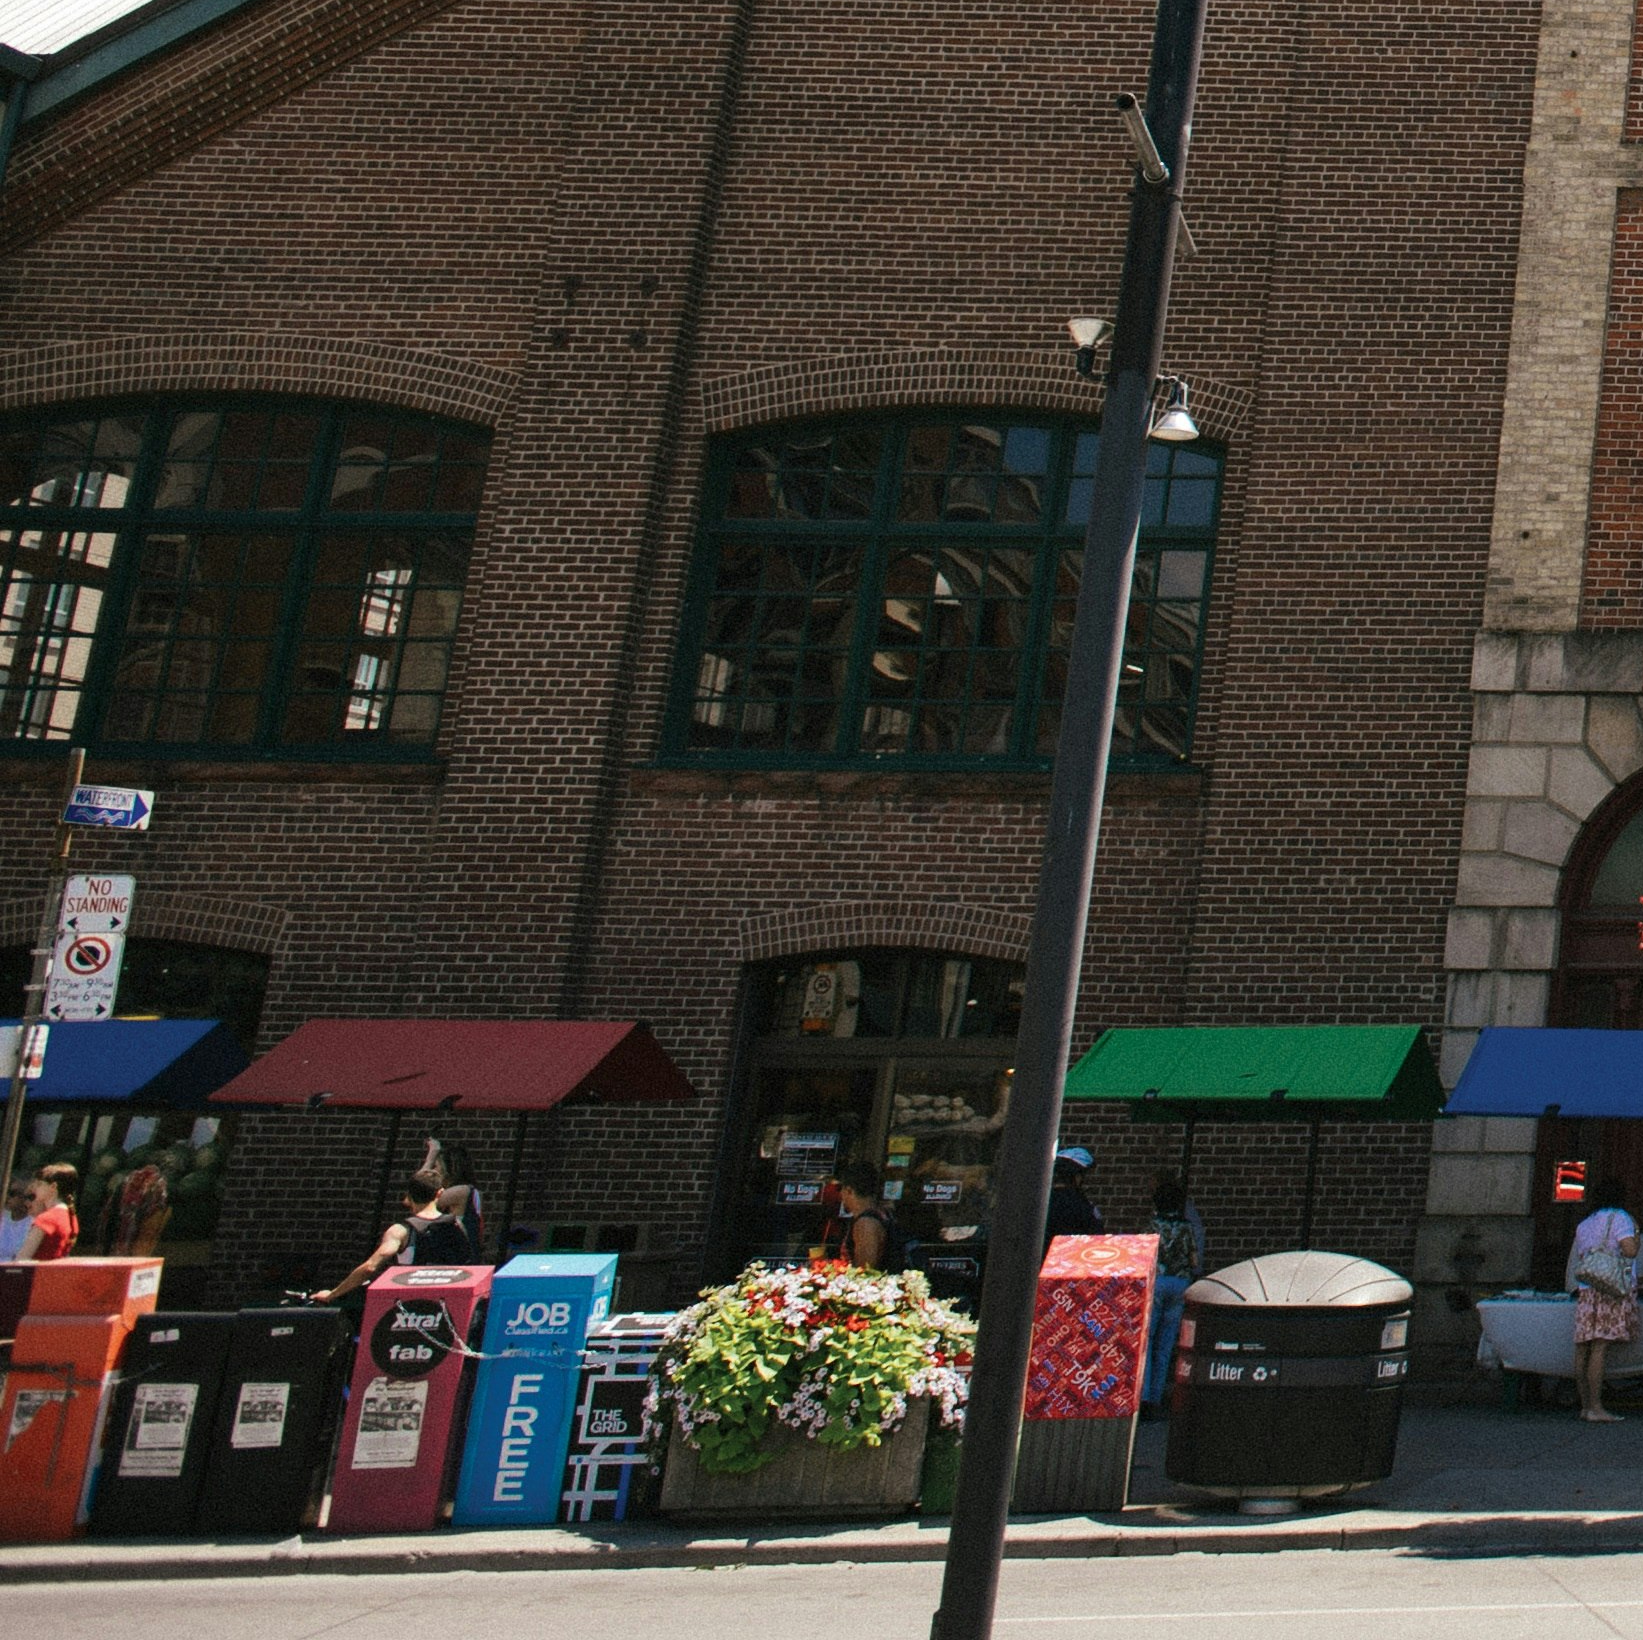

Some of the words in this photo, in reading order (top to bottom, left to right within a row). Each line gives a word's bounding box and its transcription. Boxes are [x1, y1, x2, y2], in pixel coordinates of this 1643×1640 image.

[75, 789, 133, 807] WATERFRONT
[88, 879, 112, 895] NO
[66, 897, 129, 913] STANDING
[390, 1312, 443, 1330] Xtra!
[506, 1303, 571, 1327] JOB
[504, 1325, 569, 1337] Classified.ca
[388, 1344, 433, 1360] fab
[1209, 1362, 1244, 1381] Litter
[592, 1408, 623, 1421] THE
[590, 1421, 628, 1435] GRID
[493, 1373, 544, 1502] FREE
